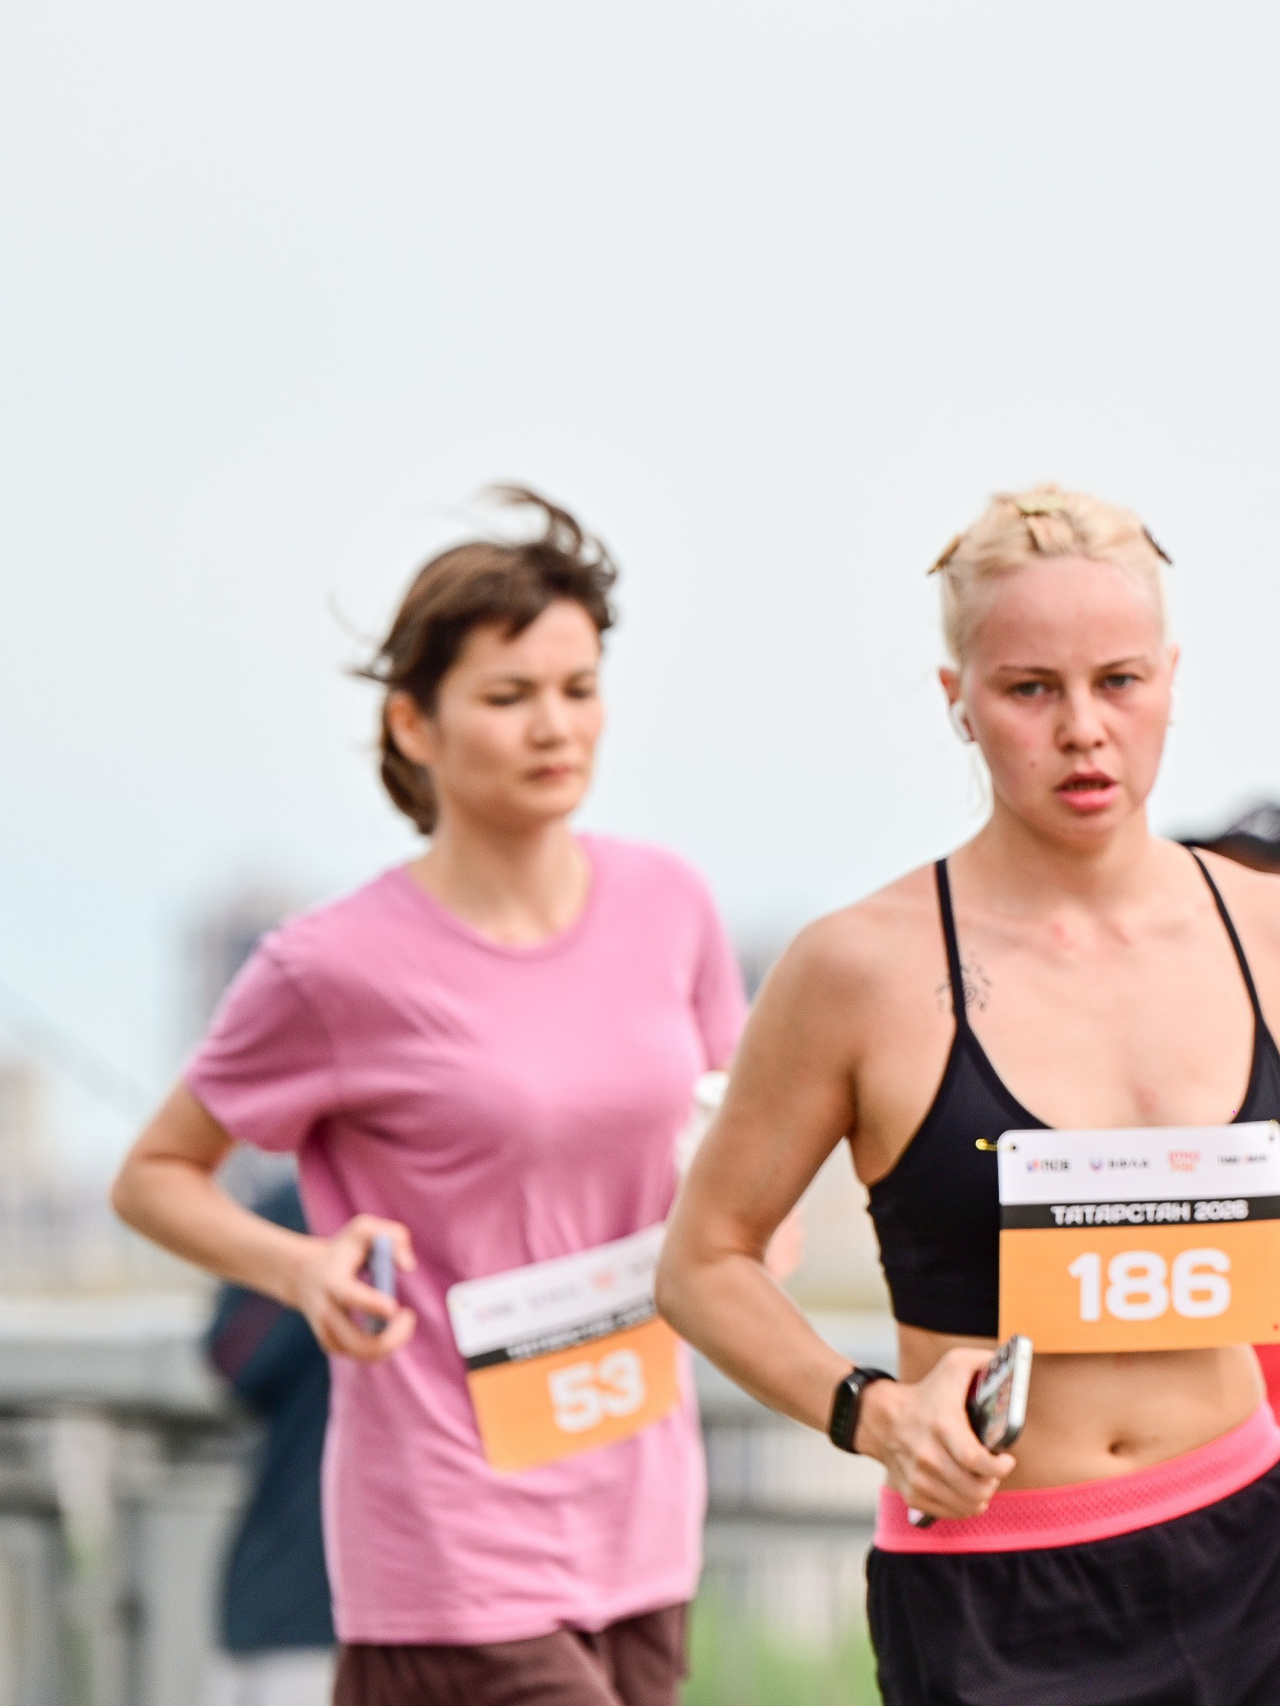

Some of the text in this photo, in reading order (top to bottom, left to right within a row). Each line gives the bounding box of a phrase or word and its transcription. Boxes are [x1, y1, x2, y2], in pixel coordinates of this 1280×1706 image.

[1050, 1202, 1191, 1226] ТАТАРСТАН
[1067, 1247, 1232, 1322] 186
[548, 1347, 644, 1434] 53
